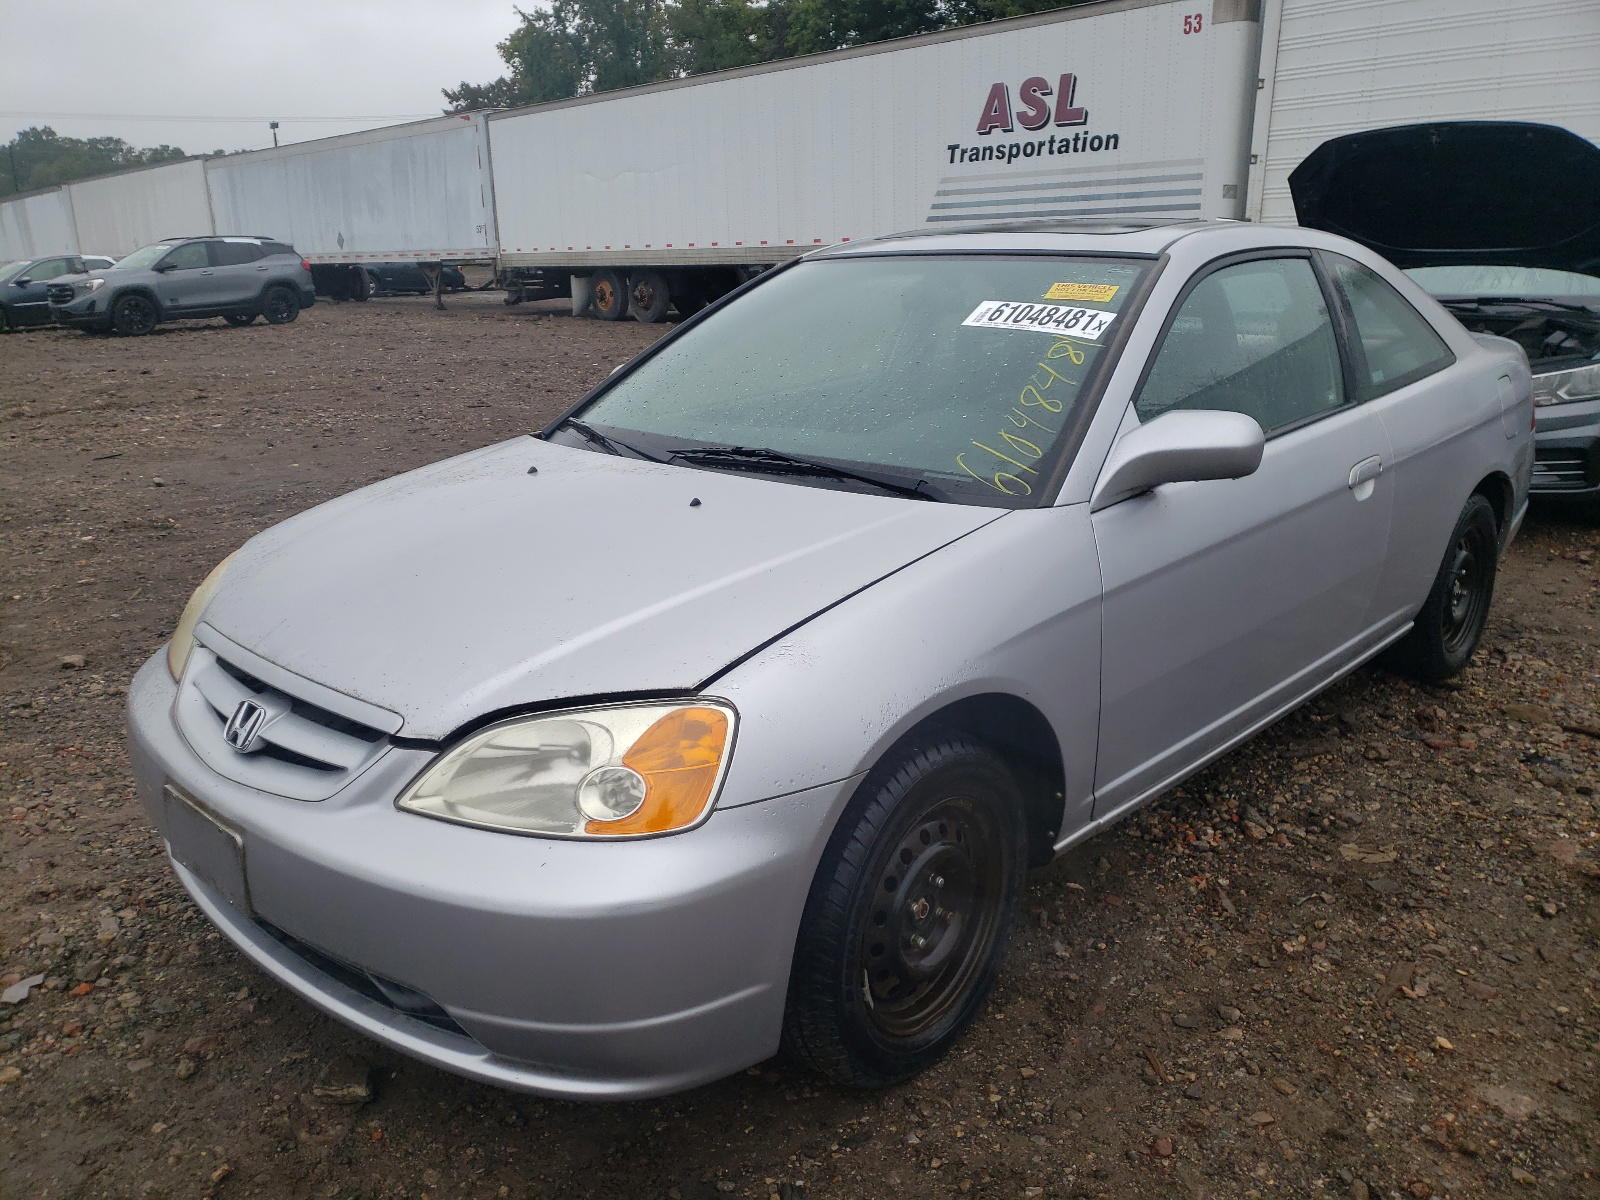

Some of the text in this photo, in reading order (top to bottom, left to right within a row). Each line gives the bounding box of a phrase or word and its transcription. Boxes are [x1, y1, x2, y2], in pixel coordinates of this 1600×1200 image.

[1184, 13, 1203, 35] 53
[976, 73, 1088, 136] ASL
[947, 131, 1120, 164] Transportation
